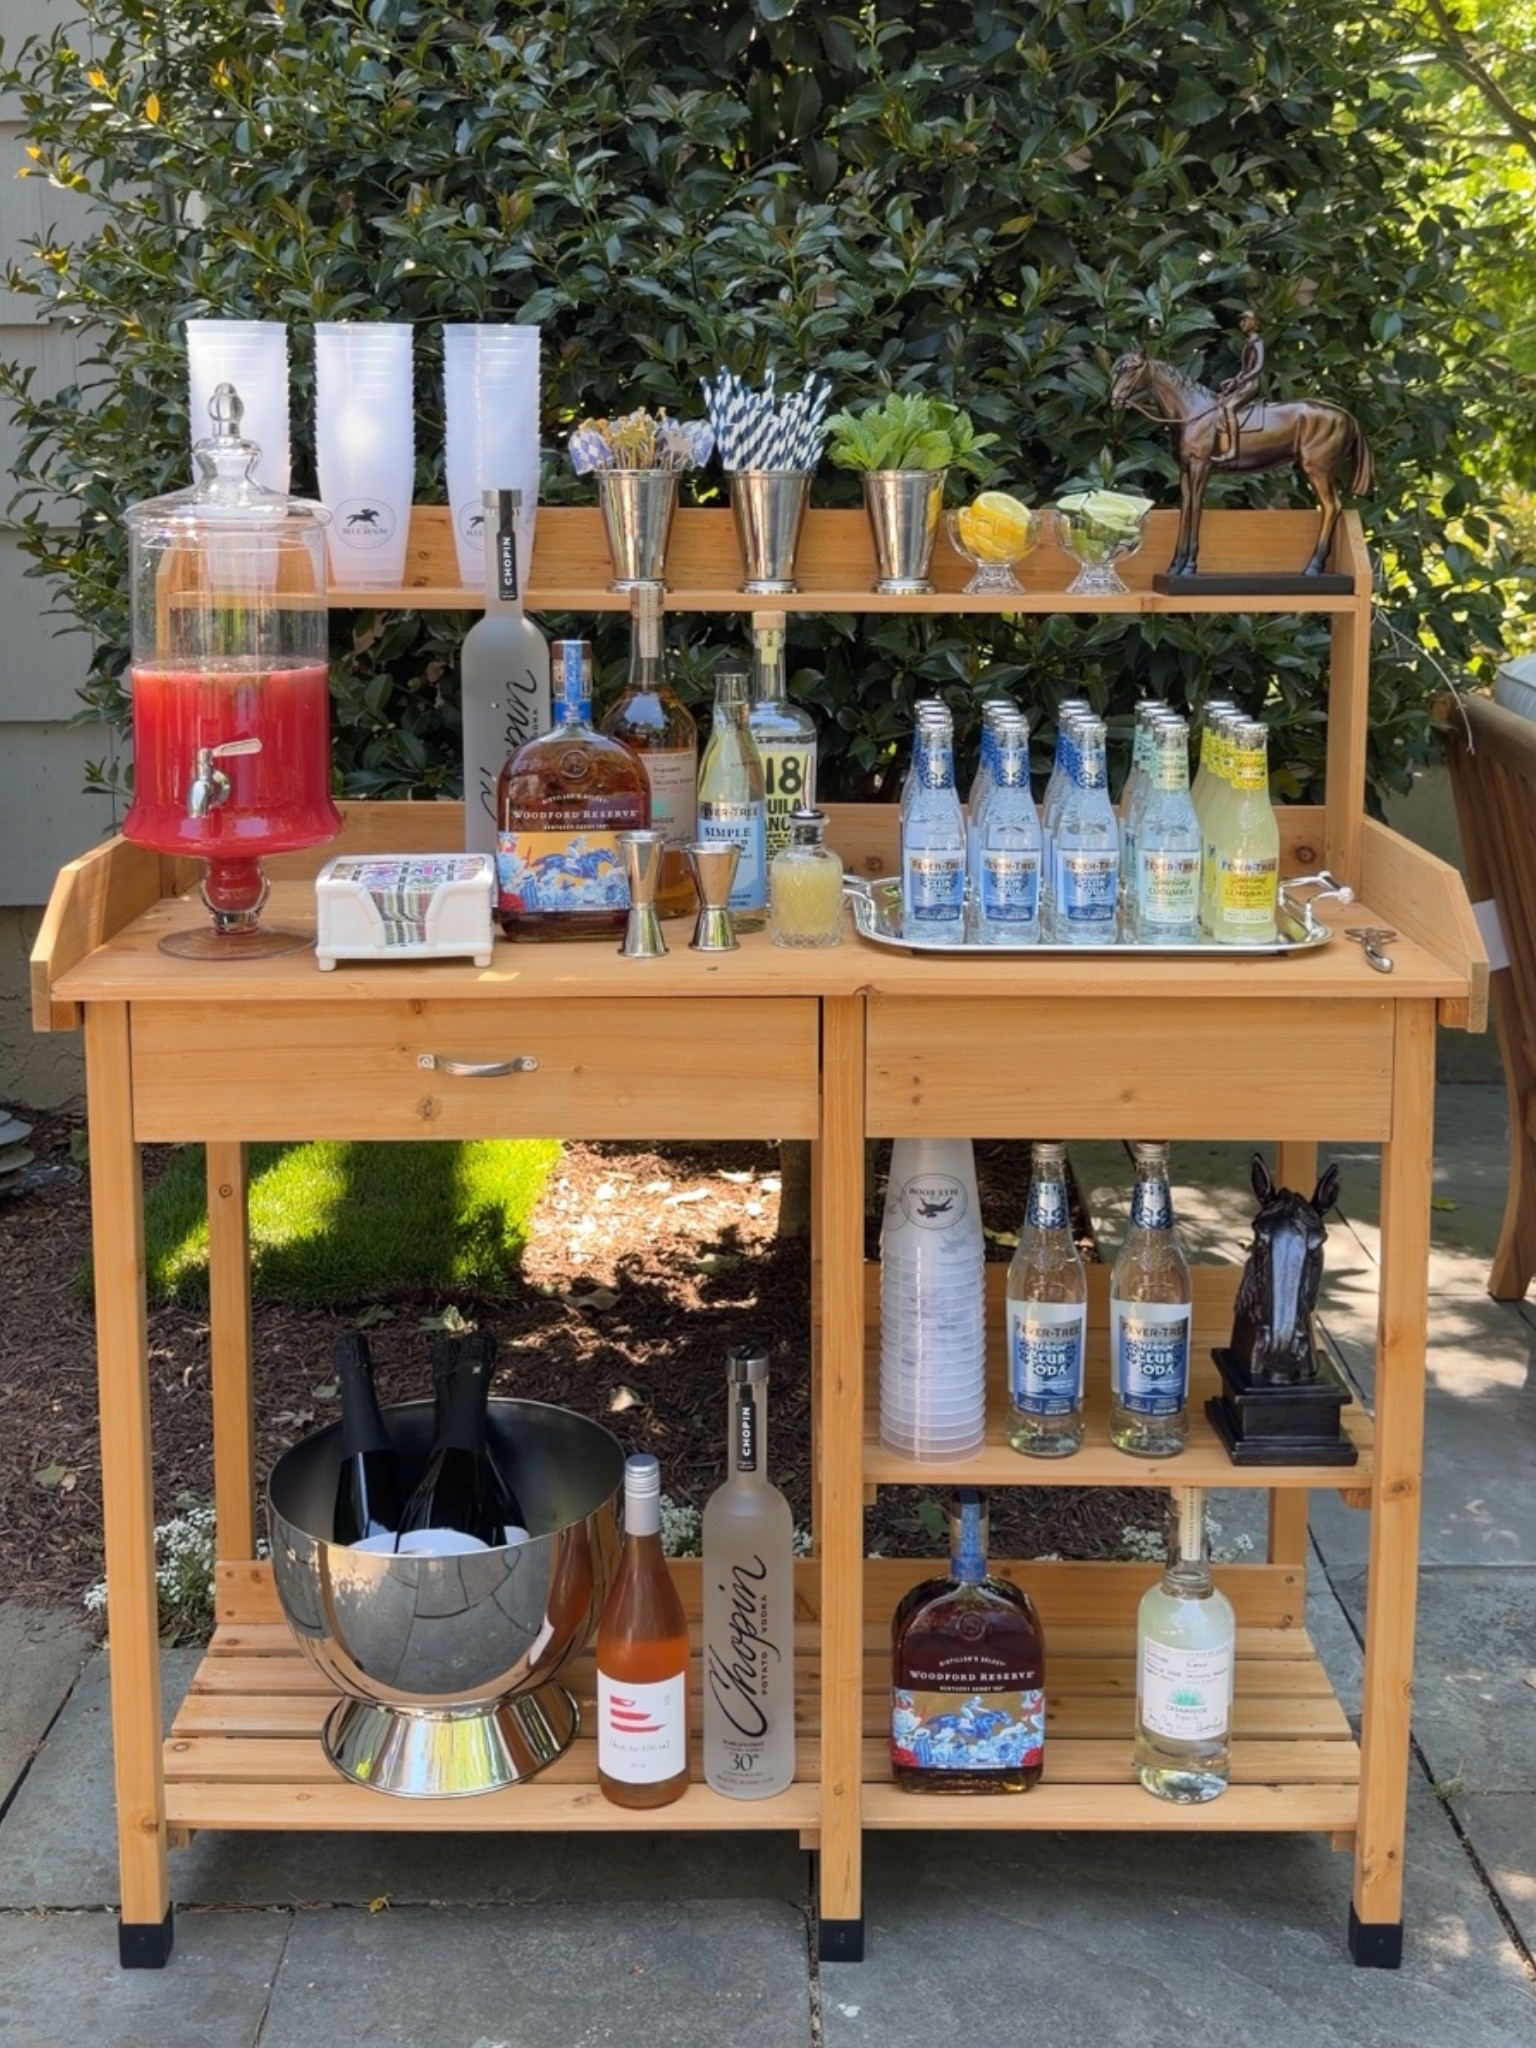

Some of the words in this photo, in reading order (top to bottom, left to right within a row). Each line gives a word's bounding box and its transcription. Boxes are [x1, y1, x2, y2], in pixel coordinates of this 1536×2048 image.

[504, 536, 513, 586] CHOPIN
[765, 756, 802, 795] 18
[765, 798, 802, 815] UILA
[512, 810, 580, 819] WOODFORD
[583, 810, 639, 819] RESERVE
[704, 826, 752, 838] SIMPLE
[1144, 859, 1199, 872] FEVER-TREE
[1222, 860, 1277, 872] FEVER-TREE
[1016, 1321, 1080, 1338] FEVER-TREE
[1122, 1322, 1189, 1338] FEVER-TREE
[1027, 1352, 1066, 1364] CLUB
[1135, 1352, 1174, 1364] CLUB
[742, 1406, 752, 1457] CHOPIN
[708, 1554, 781, 1738] Chopin
[909, 1670, 976, 1682] WOODFORD
[980, 1670, 1036, 1682] RESERVE
